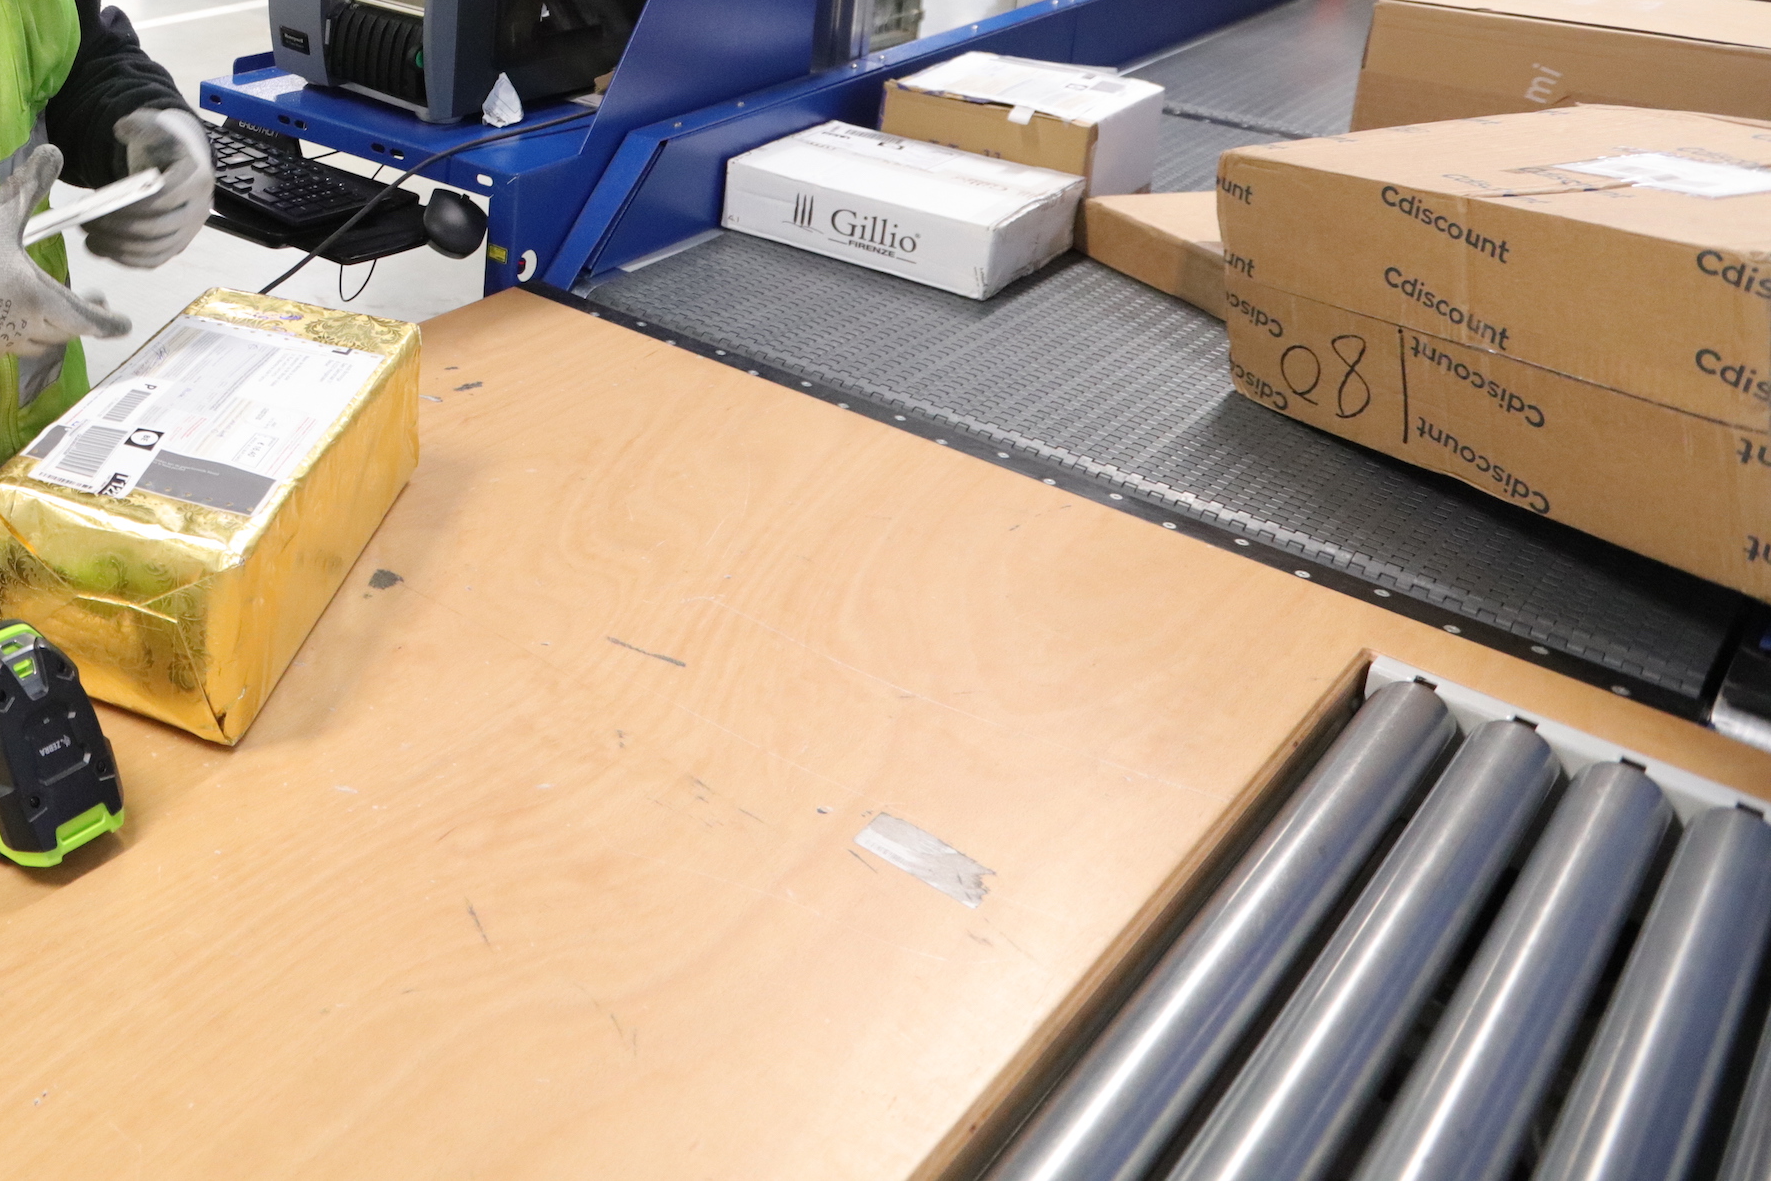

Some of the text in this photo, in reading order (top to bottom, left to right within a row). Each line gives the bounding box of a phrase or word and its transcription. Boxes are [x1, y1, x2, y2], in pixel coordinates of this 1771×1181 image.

[848, 240, 896, 259] FIRENZE
[1381, 185, 1511, 265] Cdiscount
[1226, 290, 1284, 339] Cdisc
[1384, 266, 1511, 352] Cdiscount
[1229, 355, 1289, 412] Cdisc
[1410, 336, 1546, 429] Cdiscount
[1417, 416, 1551, 516] Cdiscount
[39, 740, 62, 757] ZEBRA
